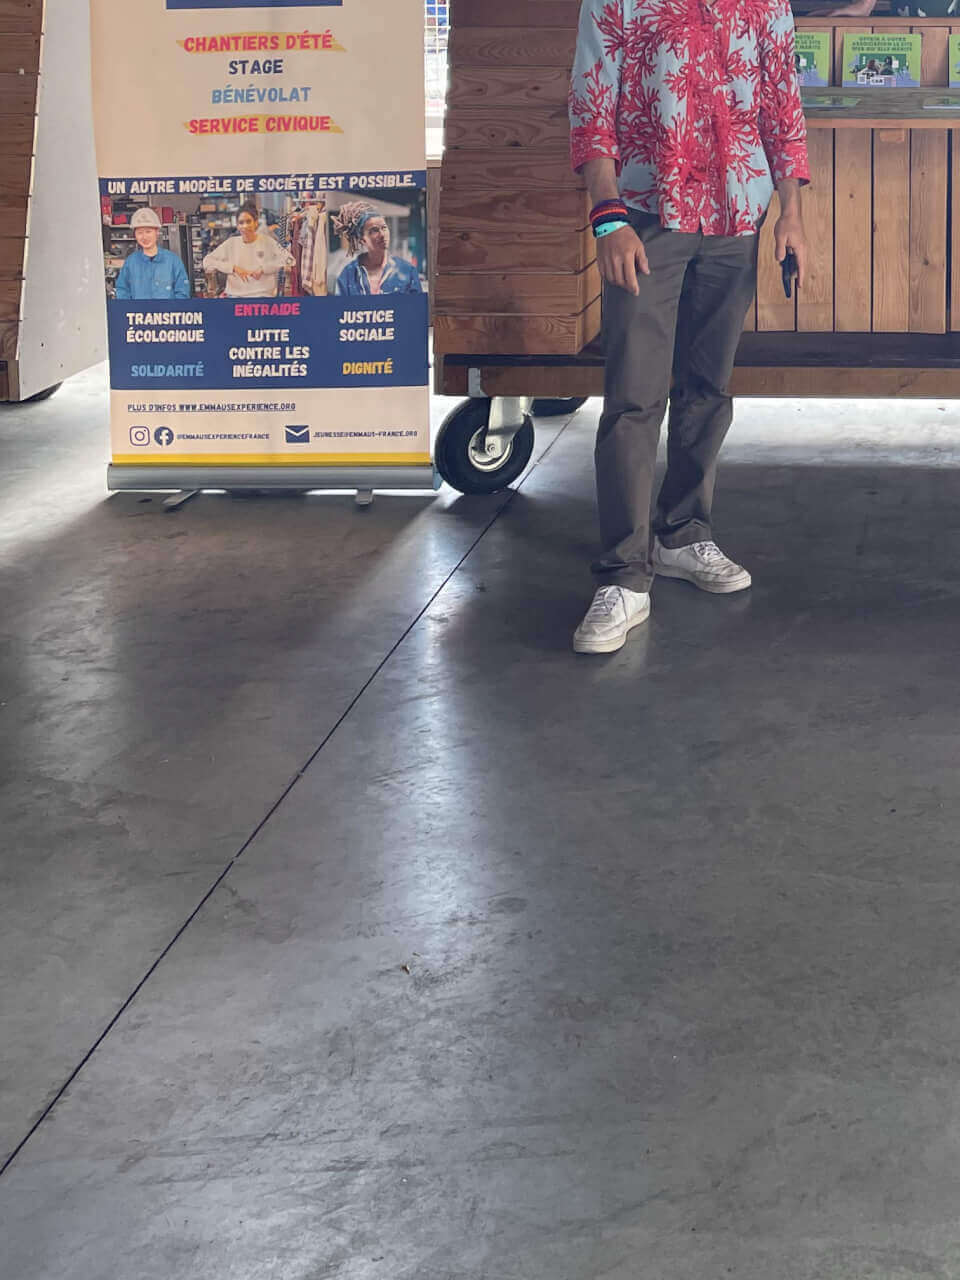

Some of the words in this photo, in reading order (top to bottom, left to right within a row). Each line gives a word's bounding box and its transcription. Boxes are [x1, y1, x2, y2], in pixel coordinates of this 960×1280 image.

[183, 35, 279, 52] CHANTIERS
[286, 29, 333, 50] D'ÉTÉ
[229, 59, 284, 75] STAGE
[211, 84, 312, 104] BÉNÉVOLAT
[189, 118, 259, 134] SERVICE
[265, 116, 330, 132] CIVIQUE
[108, 180, 126, 194] UN
[130, 179, 174, 194] AUTRE
[179, 176, 232, 193] MODÈLE
[236, 177, 253, 192] DE
[258, 173, 315, 192] SOCIÉTÉ
[319, 175, 345, 190] EST
[349, 173, 416, 189] POSSIBLE.
[234, 303, 300, 316] ENTRAIDE
[339, 310, 394, 324] JUSTICE
[126, 312, 203, 325] TRANSITION
[126, 325, 205, 343] ÉCOLOGIQUE
[247, 329, 289, 342] LUTTE
[339, 328, 395, 341] SOCIALE
[229, 347, 281, 360] CONTRE
[286, 346, 310, 359] LES
[131, 361, 204, 377] SOLIDARITÉ
[233, 360, 307, 378] INÉGALITÉS
[342, 358, 393, 375] DIGNITÉ
[128, 404, 146, 412] PLUS
